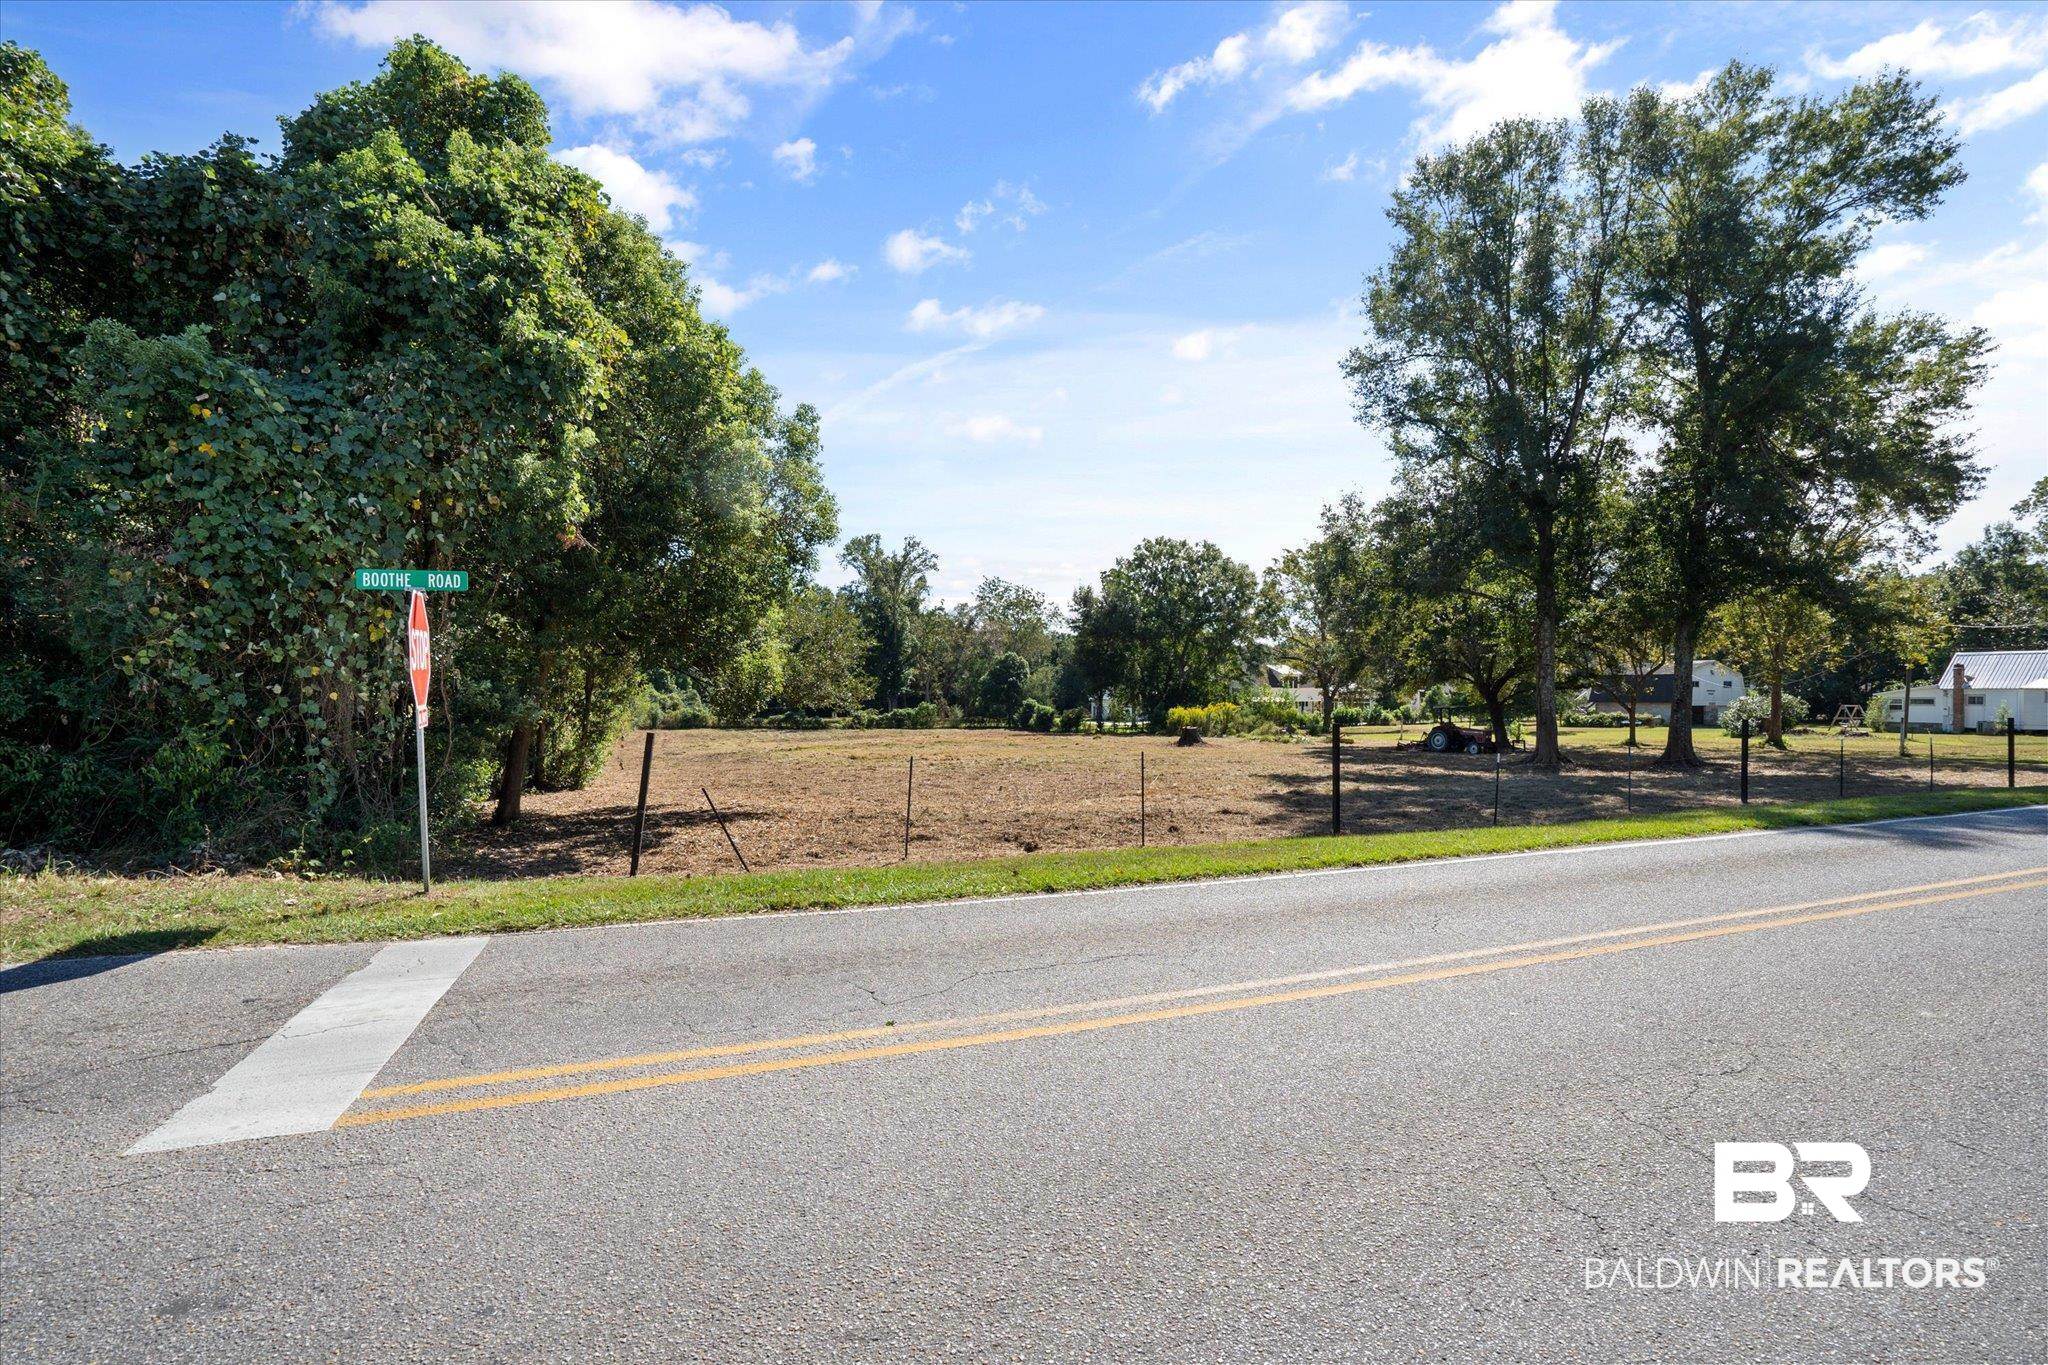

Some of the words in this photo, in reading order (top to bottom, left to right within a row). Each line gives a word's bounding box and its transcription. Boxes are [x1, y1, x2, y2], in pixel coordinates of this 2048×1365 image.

[363, 572, 411, 587] BOOTHE
[428, 574, 461, 588] ROAD
[410, 628, 429, 671] STOP
